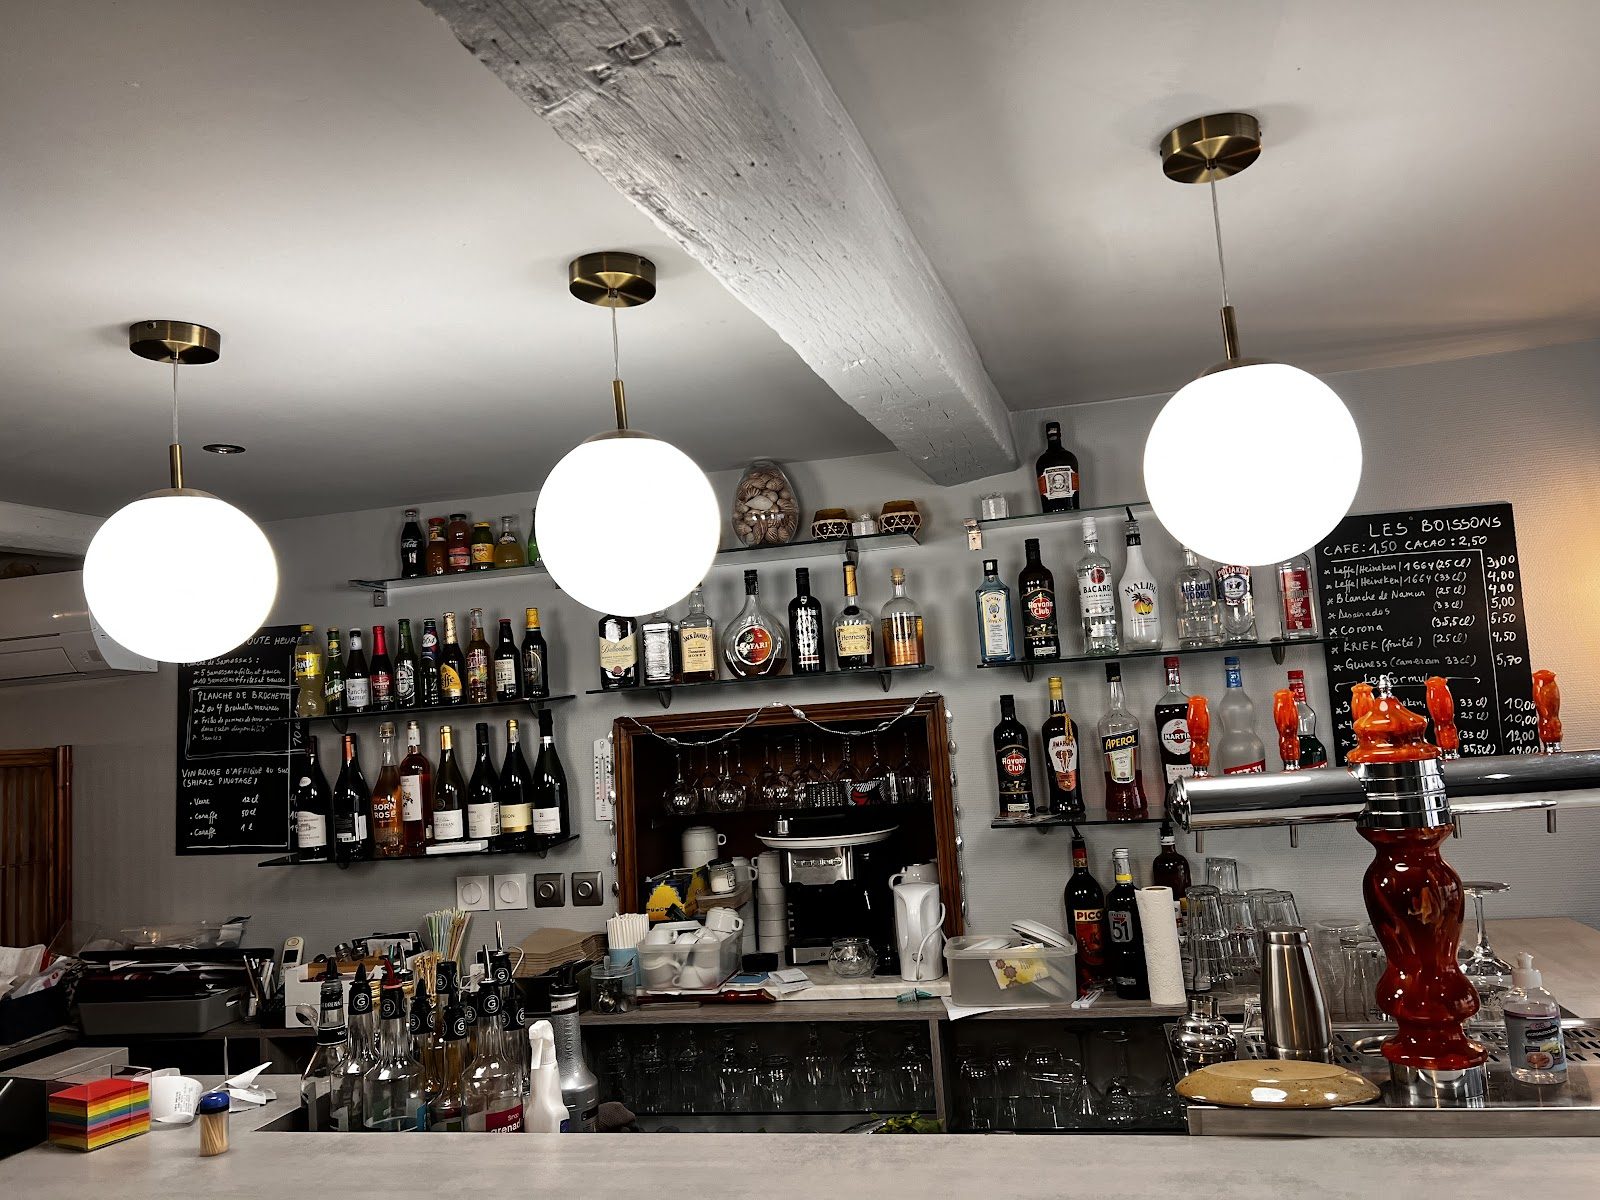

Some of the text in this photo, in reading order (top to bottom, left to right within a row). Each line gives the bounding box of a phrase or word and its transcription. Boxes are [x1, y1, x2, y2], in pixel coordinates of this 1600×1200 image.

[1369, 516, 1502, 537] LES BOISSONS
[1458, 535, 1488, 547] 2,50
[1486, 555, 1515, 569] 3,00
[1487, 571, 1515, 582] 4,00
[1124, 581, 1158, 597] MALIBU
[1181, 582, 1211, 593] ABSOLUT
[1185, 590, 1211, 599] VODKA
[1391, 590, 1426, 599] Namur
[1028, 601, 1054, 609] Havana
[1490, 597, 1515, 609] 5,00
[1491, 612, 1516, 624] 5,50
[1041, 624, 1047, 632] 7
[1341, 624, 1383, 635] Corona
[247, 636, 270, 645] OUTE
[1492, 631, 1516, 642] 4,50
[1344, 641, 1378, 652] KRIEK
[1345, 658, 1387, 670] Guiness
[1496, 653, 1522, 667] 5,70
[198, 691, 232, 702] PLANCHE
[1105, 735, 1136, 750] APEROL
[1506, 730, 1535, 744] 12,00
[1002, 757, 1026, 765] Havana
[374, 803, 396, 811] BORN
[1113, 921, 1130, 940] 51
